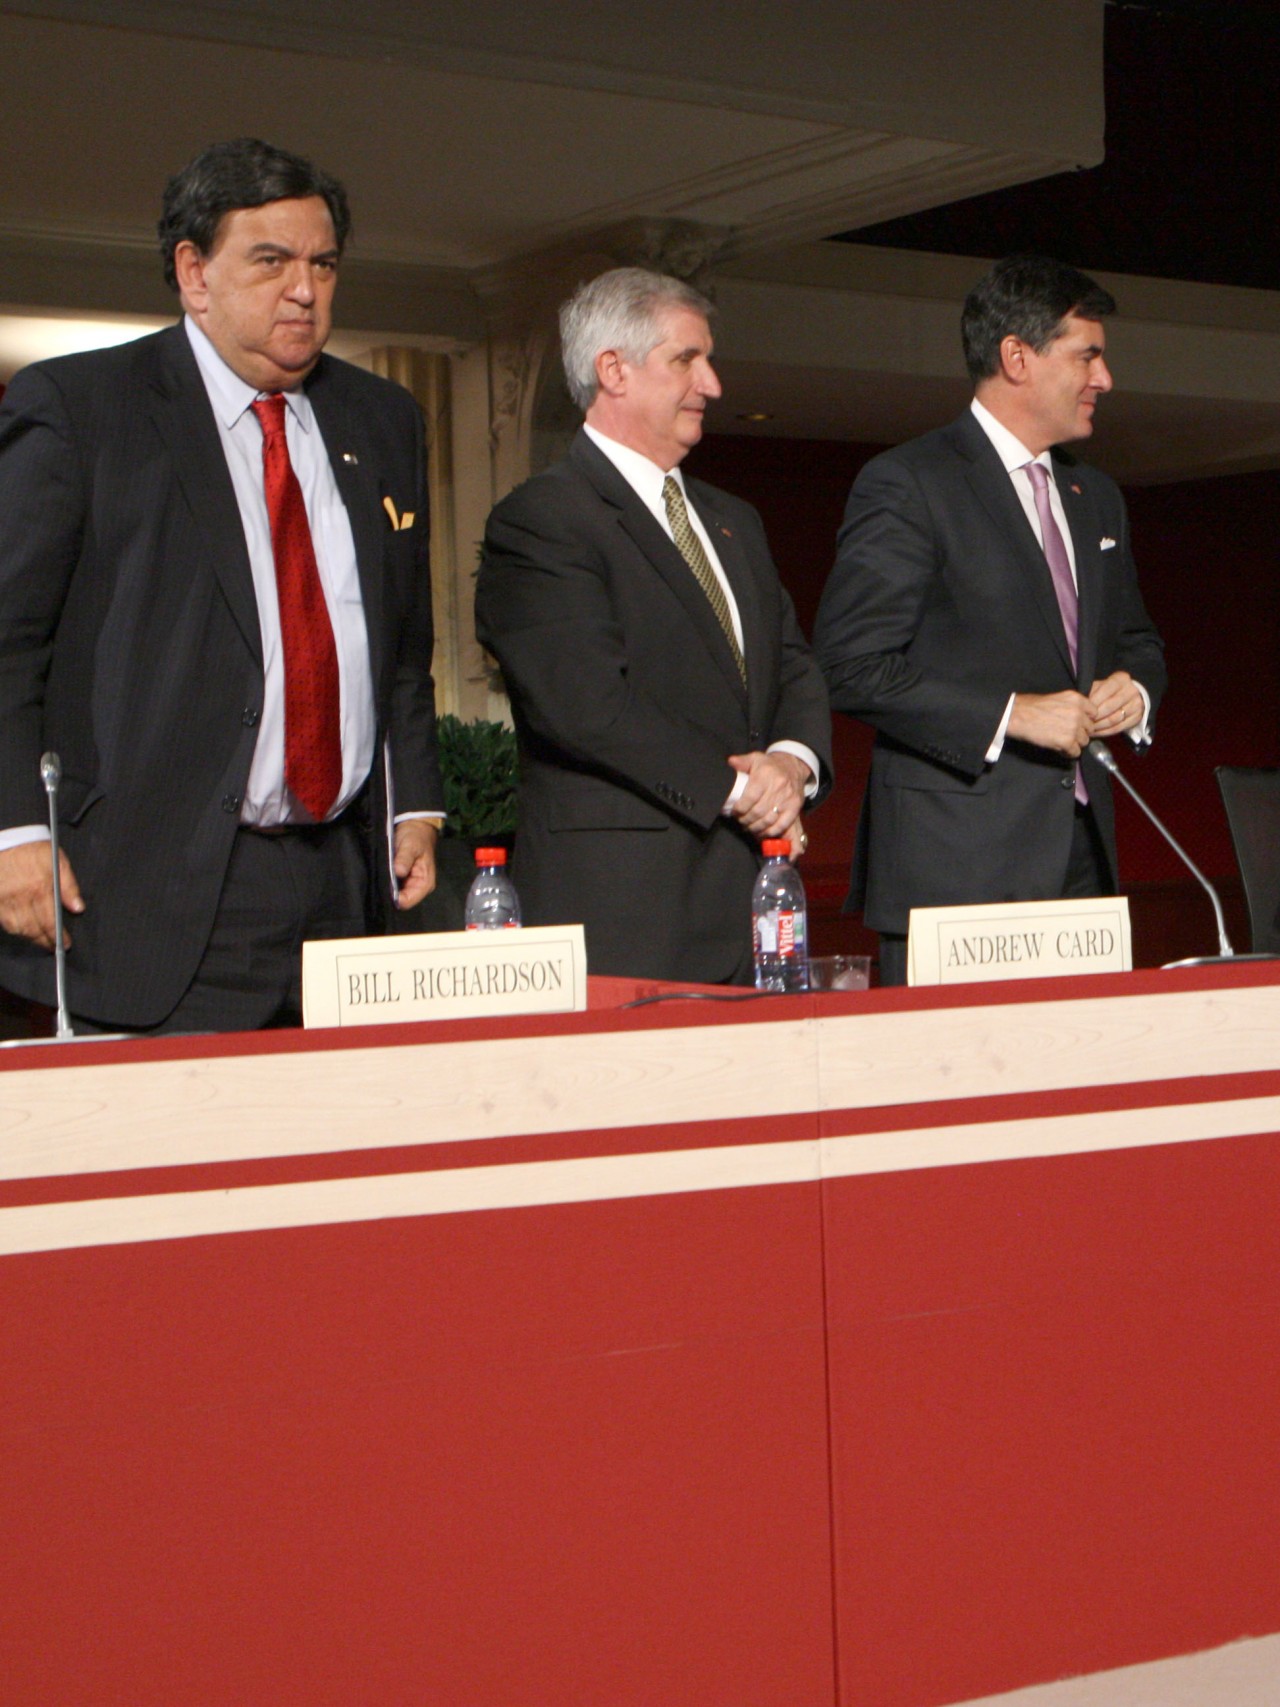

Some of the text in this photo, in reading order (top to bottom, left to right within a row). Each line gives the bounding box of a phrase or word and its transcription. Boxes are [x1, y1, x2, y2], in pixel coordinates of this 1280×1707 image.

[778, 915, 794, 956] Vittel
[947, 928, 1114, 967] ANDREW CARD
[348, 959, 563, 1006] BILL RICHARDSON
